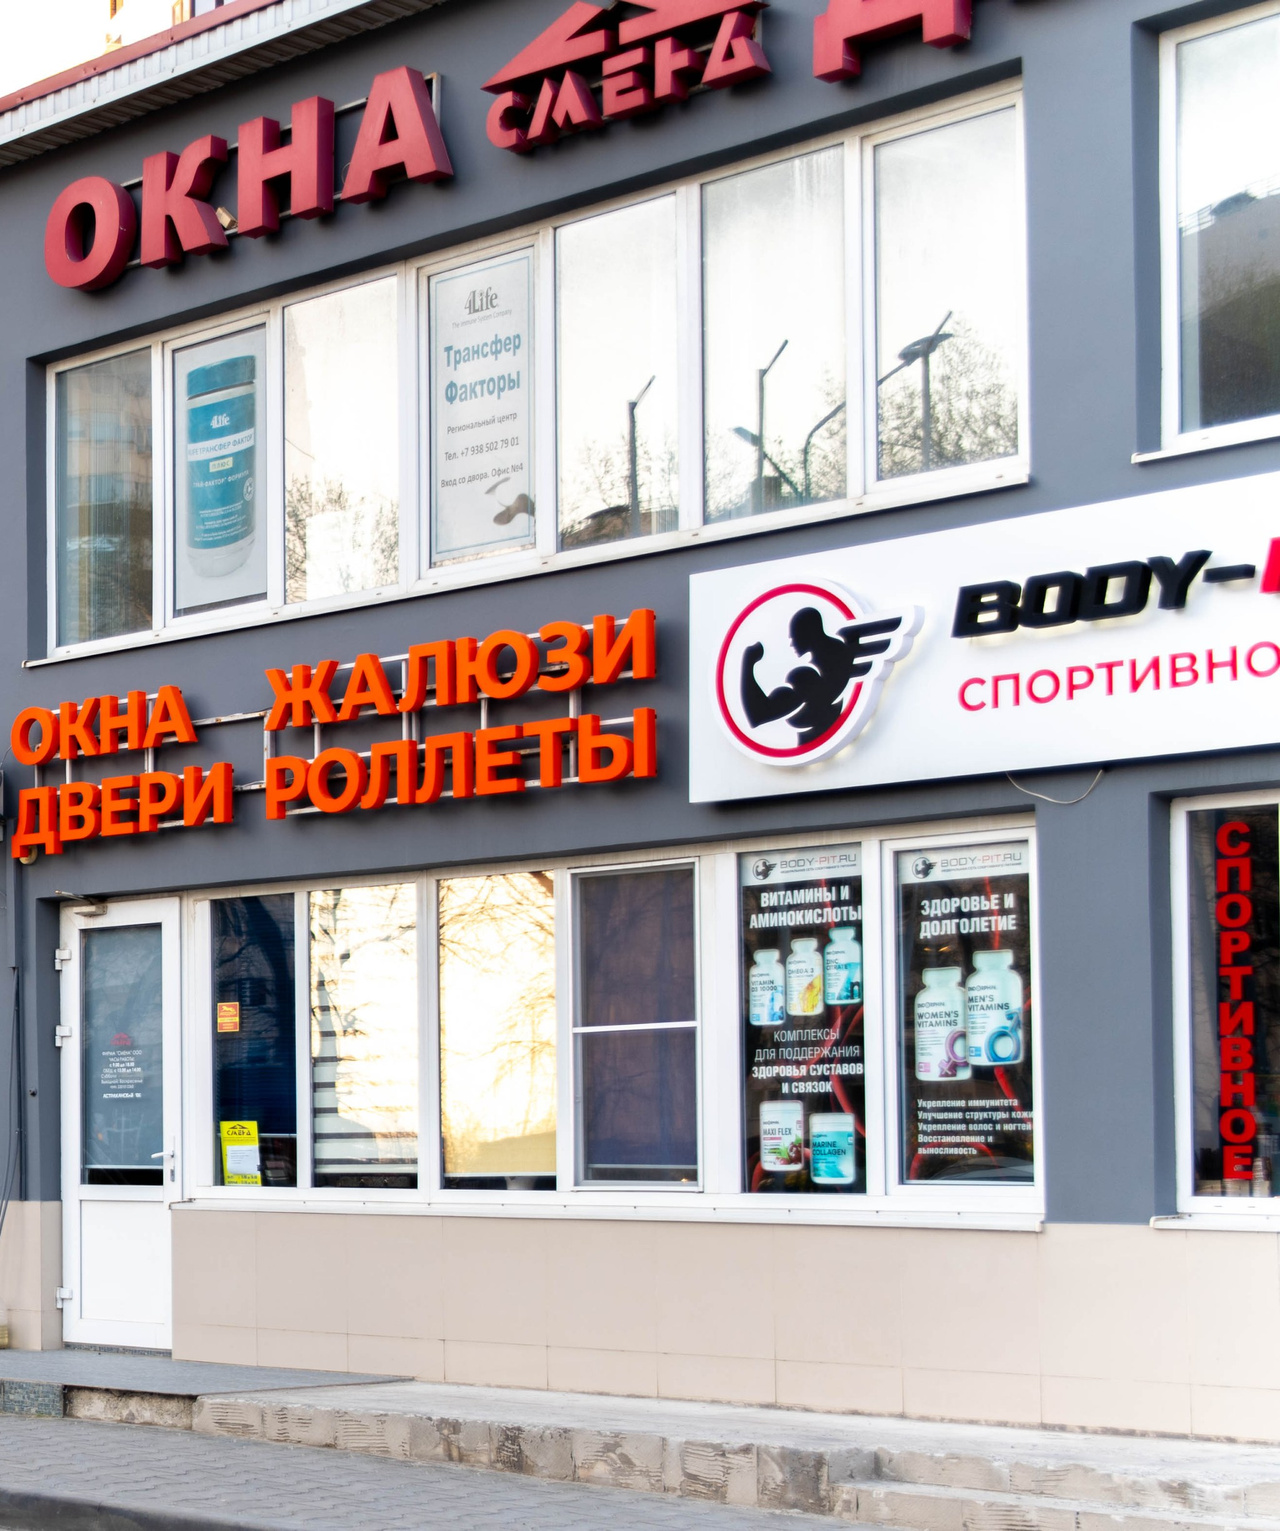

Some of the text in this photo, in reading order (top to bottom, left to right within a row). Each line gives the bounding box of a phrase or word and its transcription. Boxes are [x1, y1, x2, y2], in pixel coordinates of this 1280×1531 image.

[43, 65, 454, 293] ОКНА
[464, 286, 499, 315] 4Life
[444, 333, 522, 371] Трансфер
[445, 371, 521, 405] Факторы
[447, 412, 518, 434] Региональный центр
[445, 436, 519, 461] Тел. +7 938 502 79 01
[467, 472, 489, 483] двора.
[491, 467, 509, 477] Офис
[951, 536, 1280, 638] BODY-
[958, 641, 1280, 711] СПОРТИВНО
[9, 608, 656, 766] ОКНА ЖАЛЮЗИ
[10, 706, 656, 858] ДВЕРИ РОЛЛЕТЫ
[761, 885, 849, 907] ВИТАМИНЫ И
[921, 893, 1014, 917] ЗДОРОВЬЕ И
[749, 905, 862, 929] АМИНОКИСЛОТЫ
[920, 914, 1017, 939] ДОЛГОЛЕТИЕ
[968, 995, 994, 1003] MEN'S
[968, 1002, 1010, 1011] VITAMINS
[1215, 821, 1257, 1181] СПОРТИВНОЕ
[917, 1010, 959, 1019] WOMEN'S
[917, 1019, 958, 1028] VITAMINS
[774, 1028, 840, 1042] КОМПЛЕКСЫ
[755, 1045, 860, 1062] ДЛЯ ПОДДЕРЖАНИЯ
[752, 1063, 863, 1079] ЗДОРОВЬЯ СУСТАВОВ
[782, 1081, 832, 1094] И СВЯЗОК
[917, 1099, 1018, 1109] Укрепление иммунитета
[917, 1111, 963, 1121] Улучшение
[965, 1111, 1009, 1120] структуры
[778, 1128, 792, 1136] FLEX
[917, 1122, 966, 1132] Укрепление
[1003, 1122, 1031, 1131] ногтей
[917, 1134, 985, 1143] Восстановление
[917, 1147, 977, 1155] выносливость
